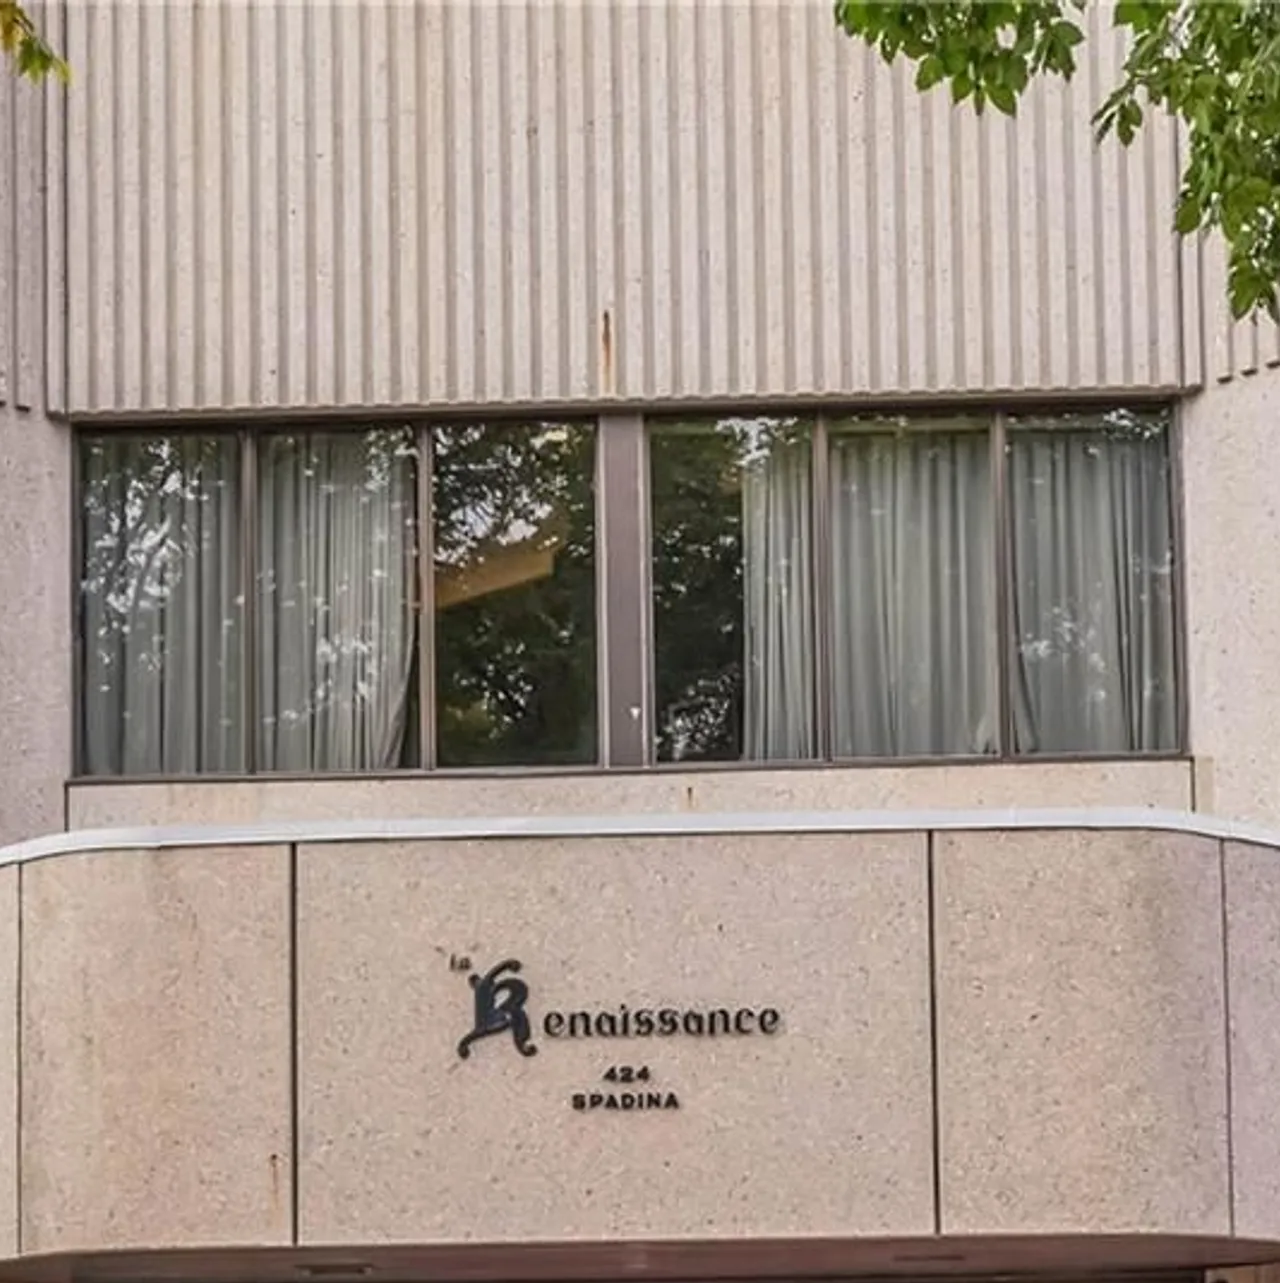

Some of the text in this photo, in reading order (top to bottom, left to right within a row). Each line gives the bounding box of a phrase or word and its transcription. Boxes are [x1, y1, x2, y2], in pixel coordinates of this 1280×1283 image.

[457, 958, 781, 1060] Renaissance
[603, 1065, 651, 1083] 424
[571, 1092, 681, 1111] SPADINA
